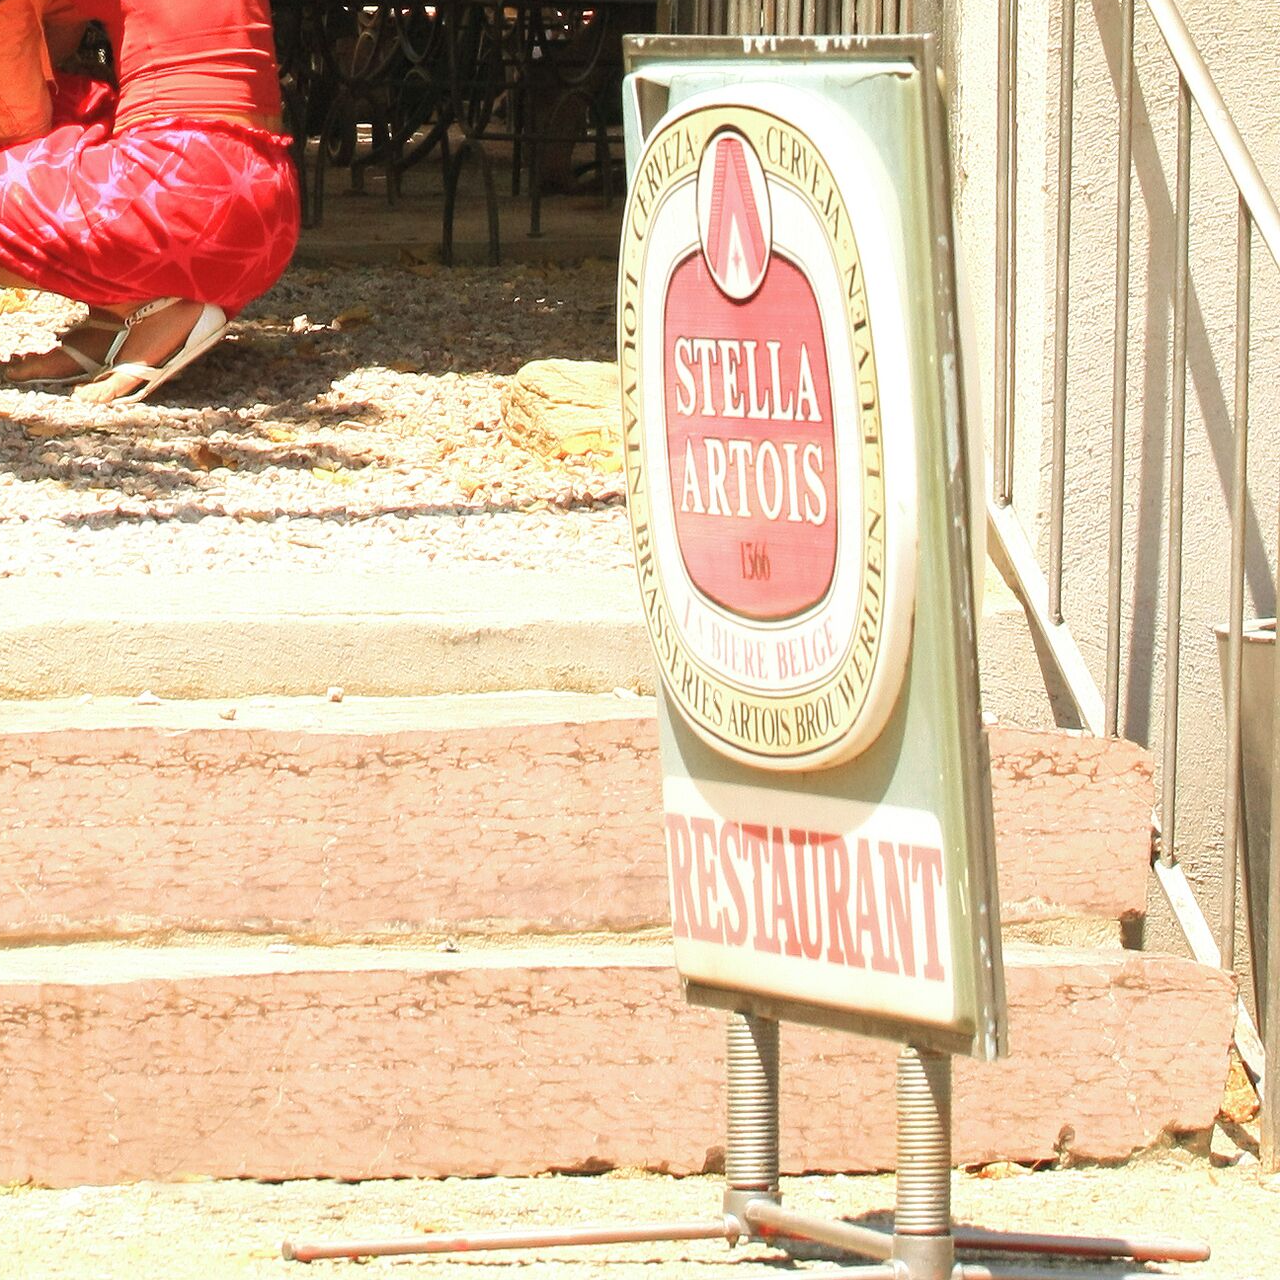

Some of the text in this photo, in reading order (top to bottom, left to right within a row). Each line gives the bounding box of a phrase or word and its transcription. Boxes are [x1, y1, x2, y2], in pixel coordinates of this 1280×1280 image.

[631, 127, 696, 242] CERVEZA
[766, 126, 841, 240] CERVEJA
[623, 271, 644, 495] LOUVAIN
[674, 335, 823, 422] STELLA
[844, 262, 881, 478] LEUVEN
[680, 436, 827, 526] ARTOIS
[635, 508, 883, 747] BRASSERIES ARTOIS BROUWERIJEN
[775, 615, 838, 681] BELGE
[664, 812, 946, 982] RESTAURANT
